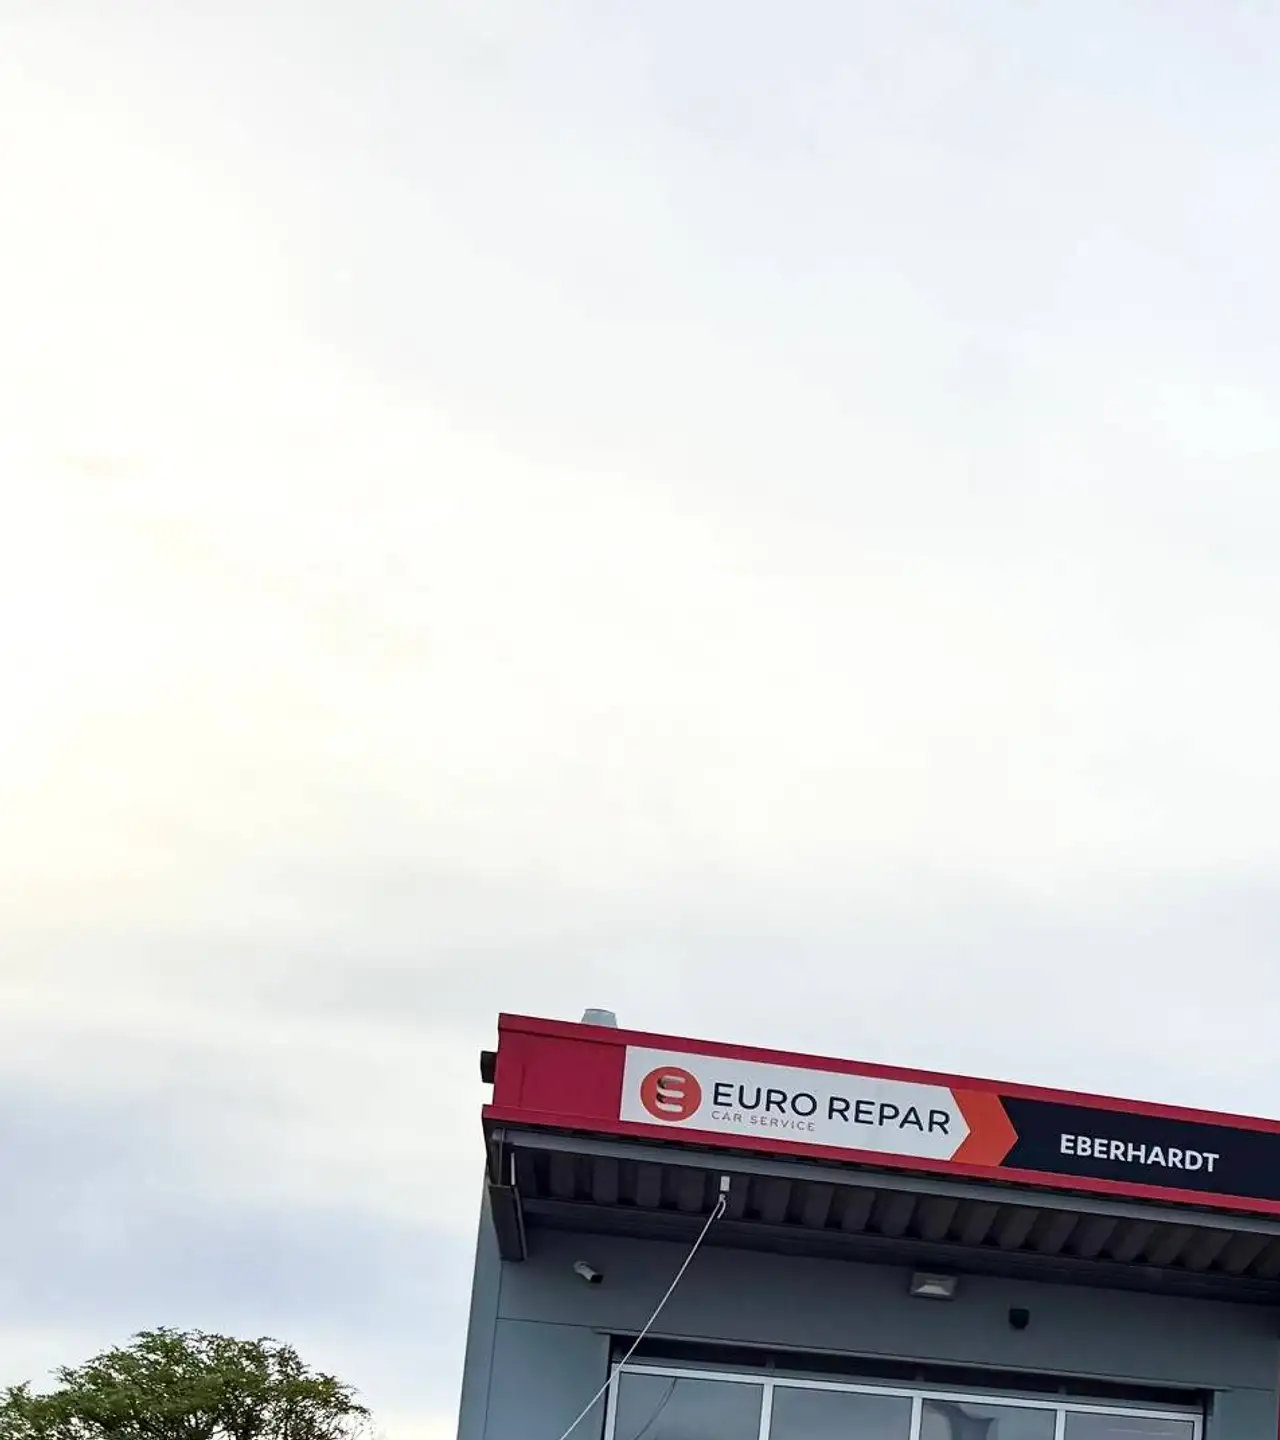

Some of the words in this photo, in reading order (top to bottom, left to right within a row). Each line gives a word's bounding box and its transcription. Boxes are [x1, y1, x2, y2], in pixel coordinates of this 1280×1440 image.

[711, 1110, 742, 1123] CAR
[750, 1115, 816, 1132] SERVICE
[712, 1082, 818, 1117] EURO
[828, 1095, 951, 1135] REPAR
[1060, 1133, 1220, 1172] EBERHARDT
